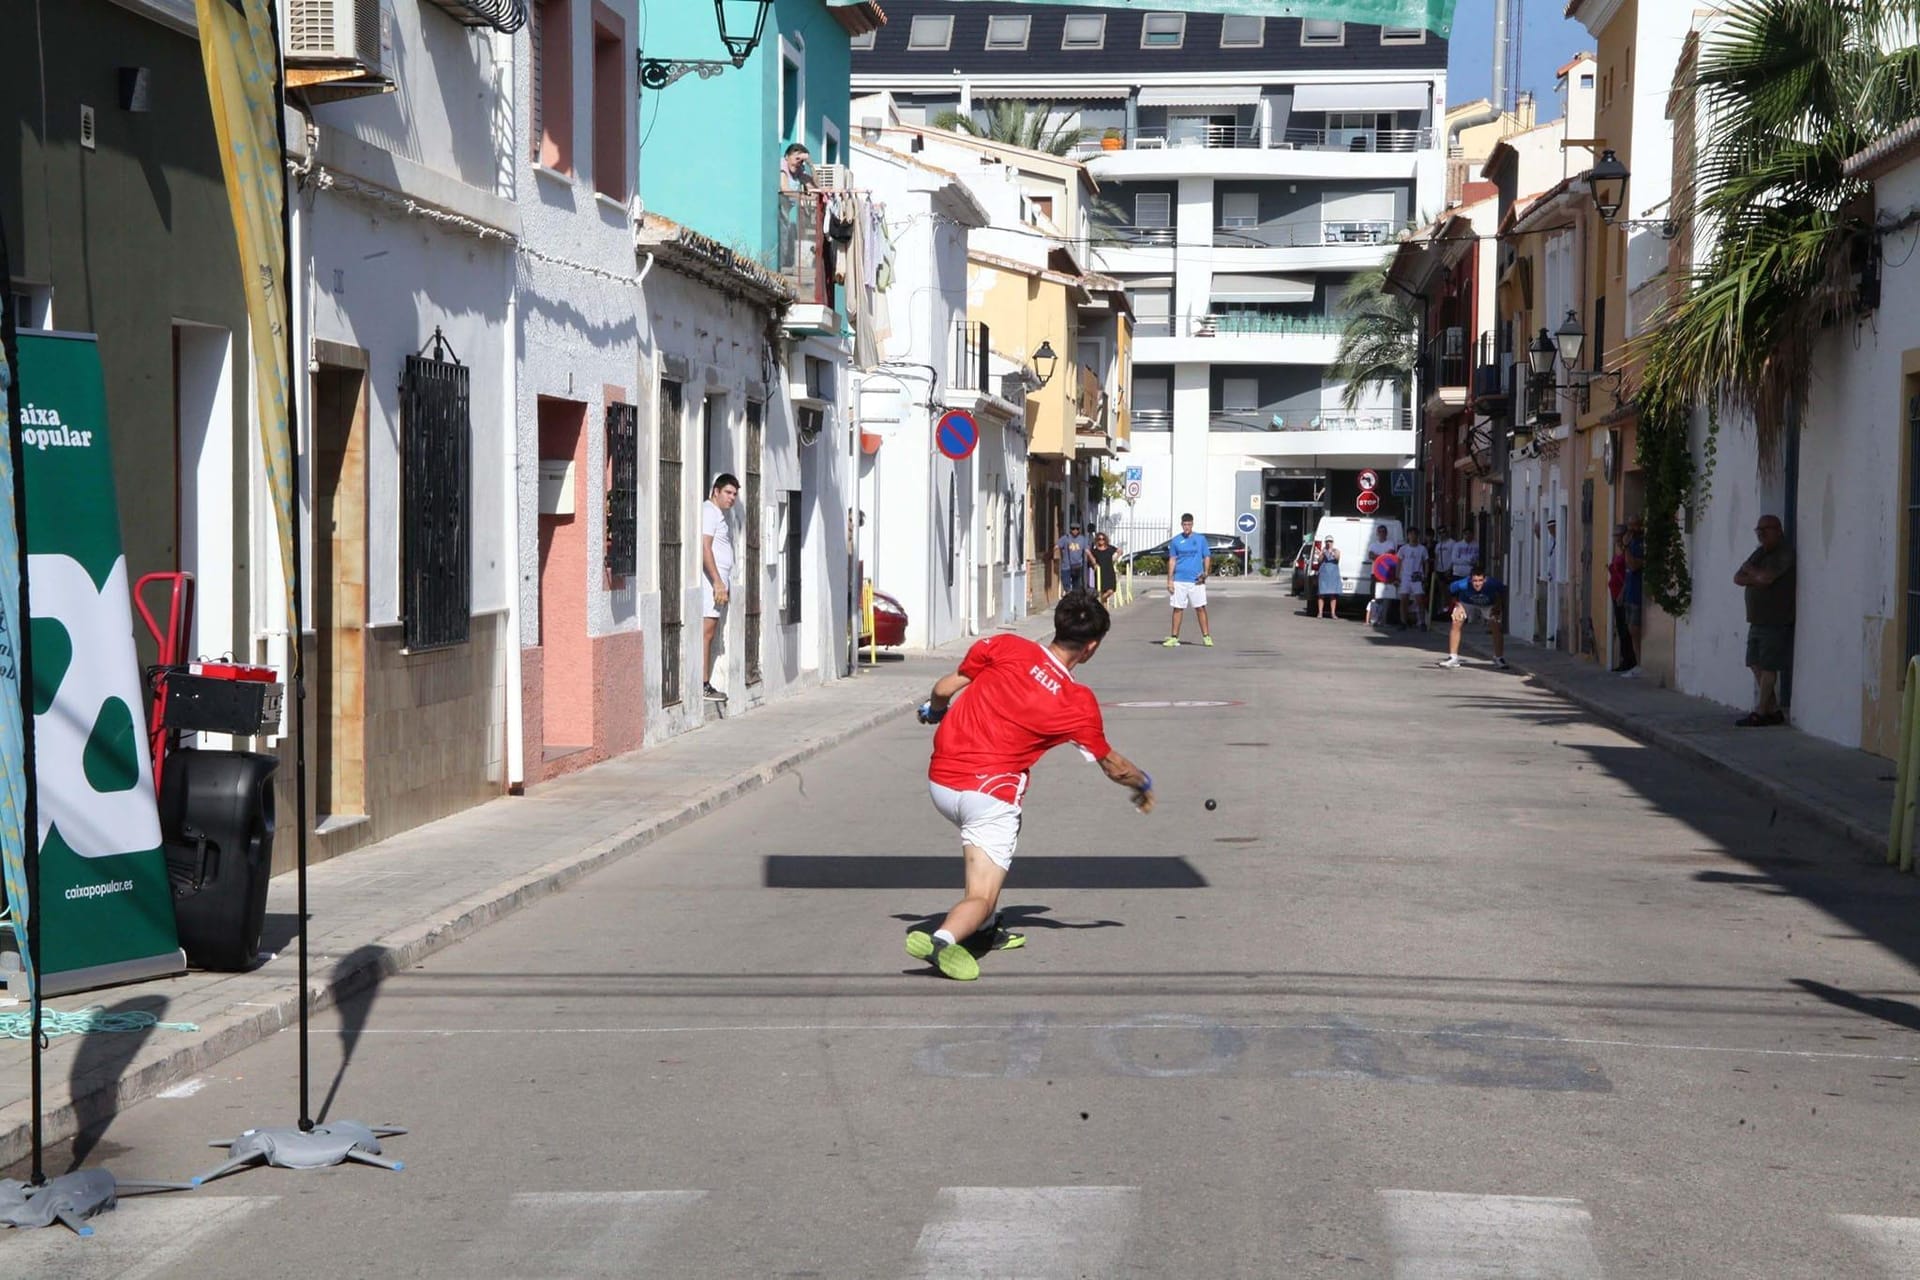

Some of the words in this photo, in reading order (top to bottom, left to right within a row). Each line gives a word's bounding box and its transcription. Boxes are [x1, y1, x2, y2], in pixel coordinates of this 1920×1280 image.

[20, 403, 60, 425] aixa
[21, 425, 92, 450] opular
[1029, 665, 1061, 695] FÉLIX
[65, 880, 133, 899] caixapopular.es
